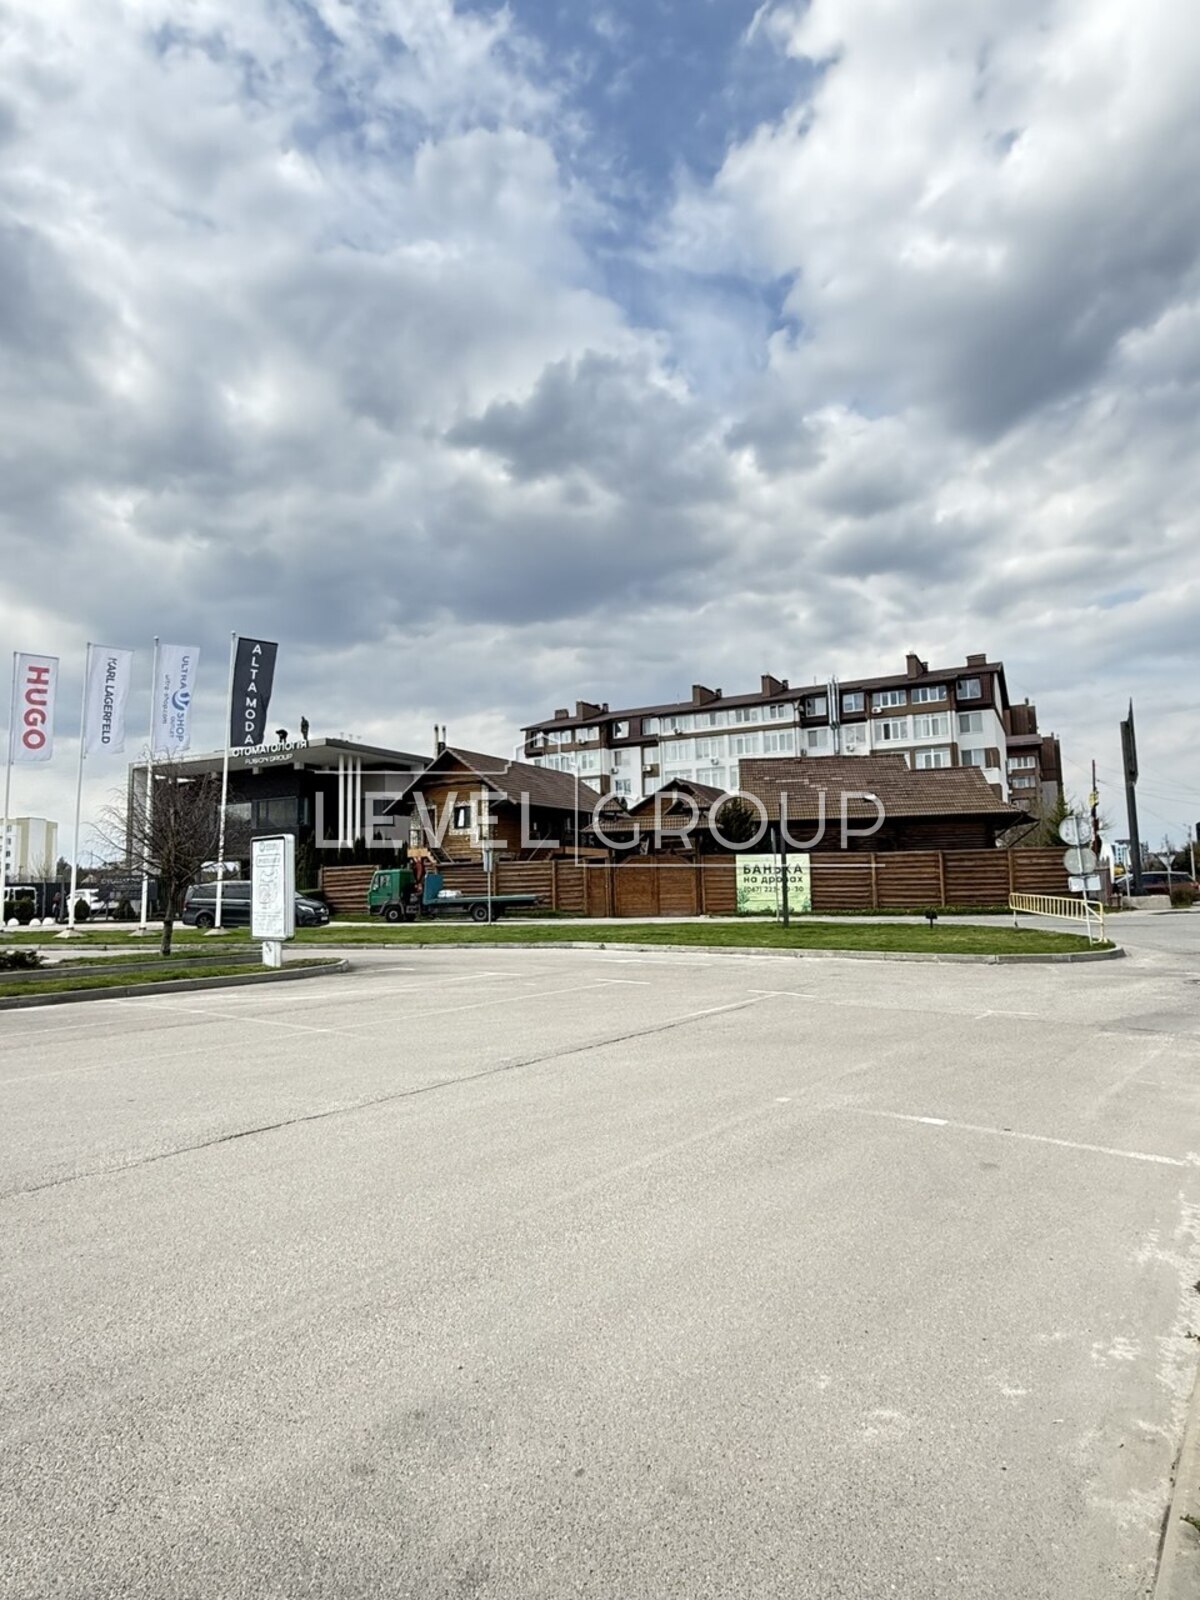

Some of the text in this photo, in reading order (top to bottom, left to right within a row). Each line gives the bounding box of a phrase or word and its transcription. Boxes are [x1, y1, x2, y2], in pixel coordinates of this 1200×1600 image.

[22, 665, 50, 750] HUGO
[101, 657, 118, 744] KARL LAGERFELD
[176, 655, 190, 742] ULTRA SHOP
[244, 644, 262, 744] ALTA MODA
[761, 876, 803, 885] дроах
